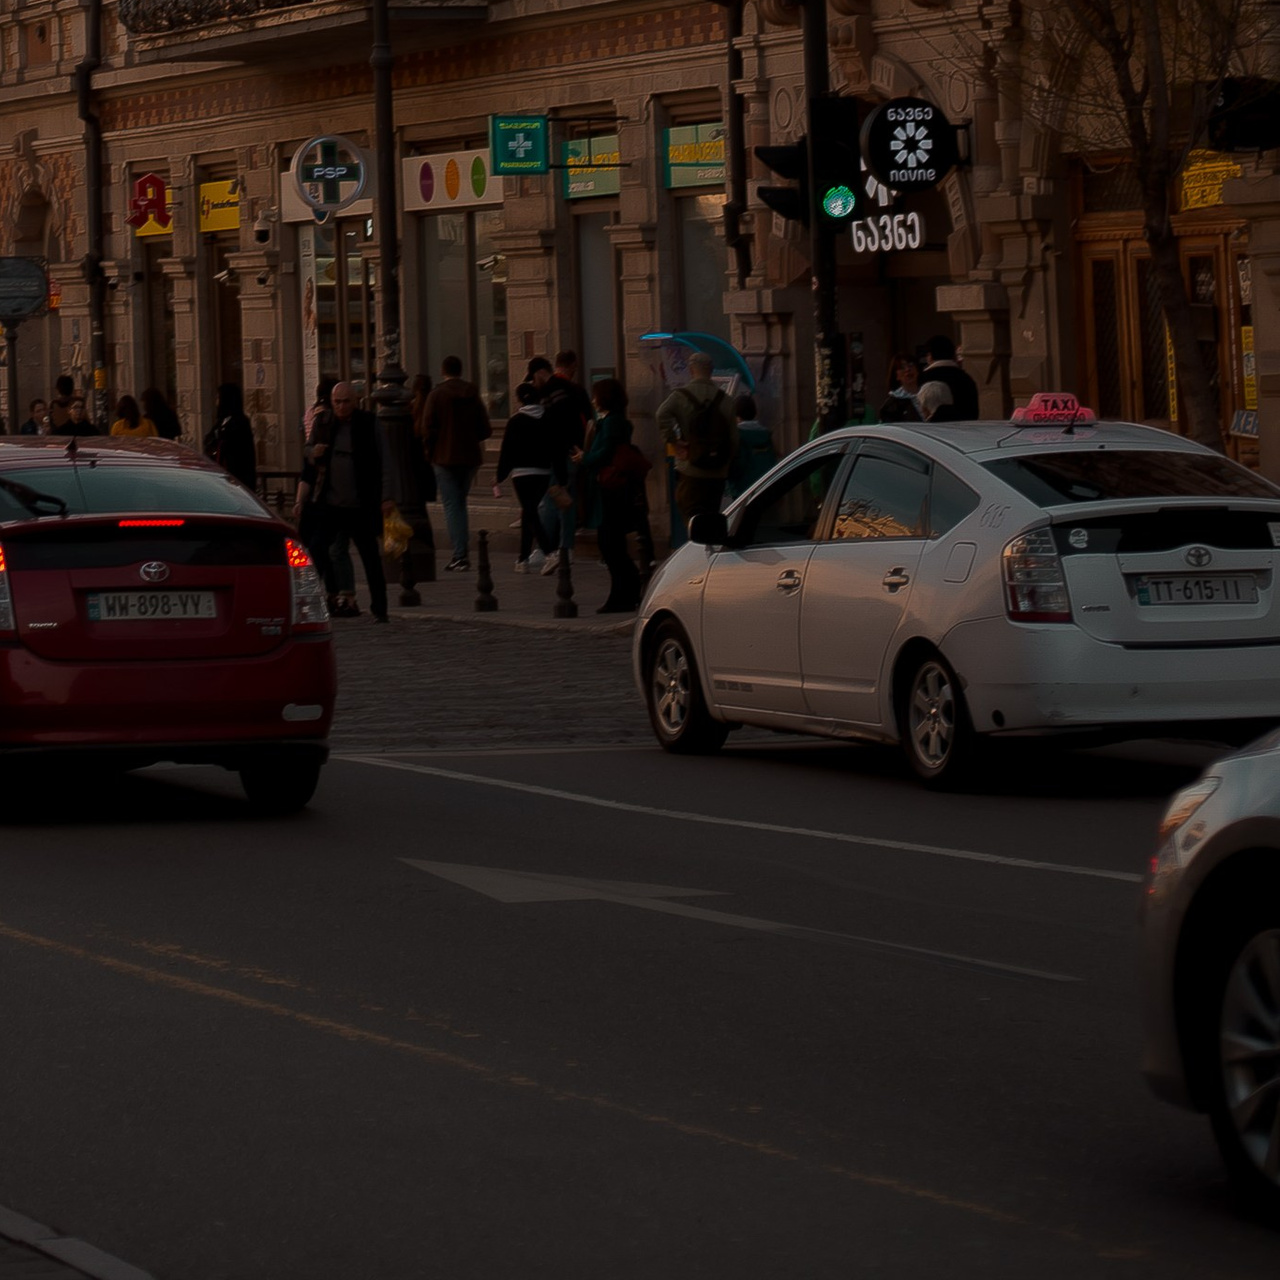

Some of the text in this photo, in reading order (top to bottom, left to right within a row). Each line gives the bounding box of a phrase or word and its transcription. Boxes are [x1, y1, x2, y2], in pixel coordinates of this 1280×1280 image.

[886, 106, 934, 122] ნავნე
[313, 166, 348, 180] PSP
[888, 168, 937, 183] navne
[851, 211, 922, 254] ნავნე
[1041, 398, 1076, 412] TAXI
[980, 502, 1012, 529] 615
[1150, 579, 1242, 602] TT-615-II
